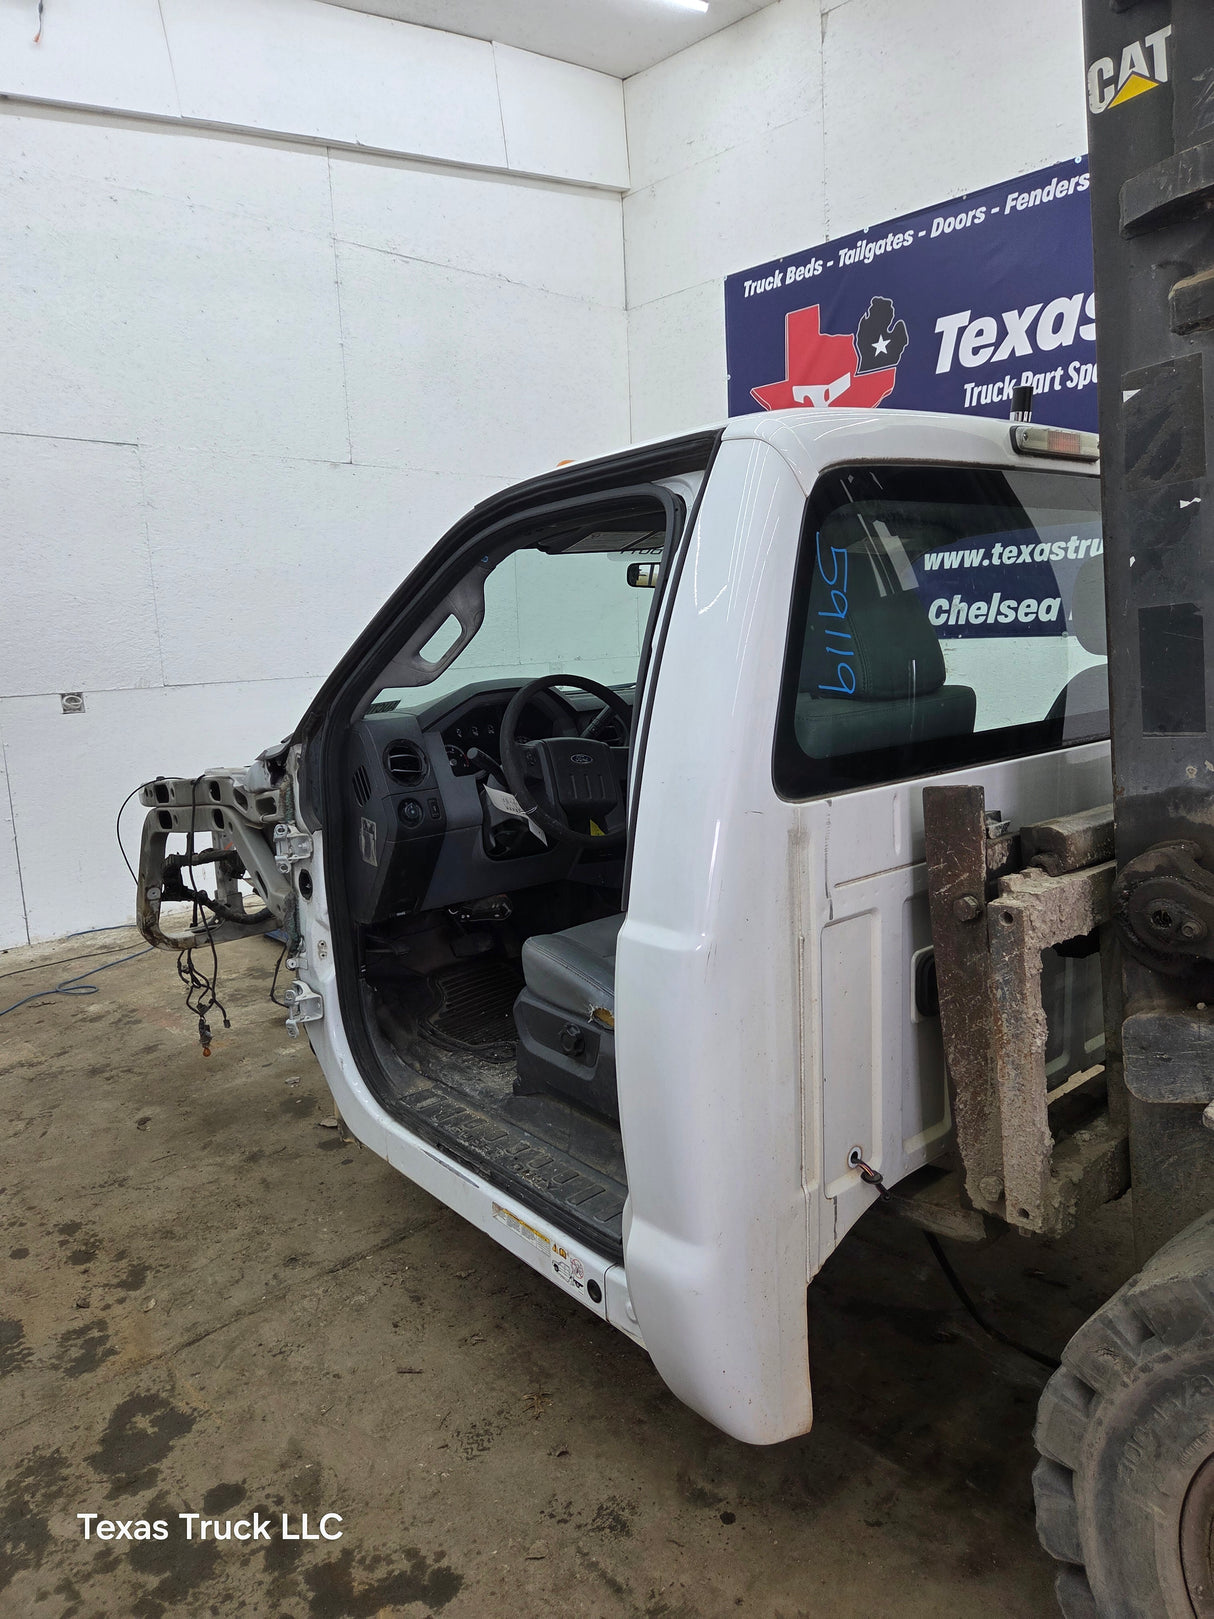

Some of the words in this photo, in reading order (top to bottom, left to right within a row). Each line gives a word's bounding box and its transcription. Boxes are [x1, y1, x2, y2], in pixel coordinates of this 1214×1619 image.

[1088, 24, 1172, 114] CAT
[744, 270, 783, 298] Truck
[785, 258, 824, 285] Beds
[838, 230, 914, 267] Tailgates
[930, 206, 987, 239] Doors
[1004, 172, 1090, 215] Fenders
[964, 375, 1017, 408] Truck
[1021, 366, 1064, 396] Part
[928, 592, 1062, 626] Chelsea
